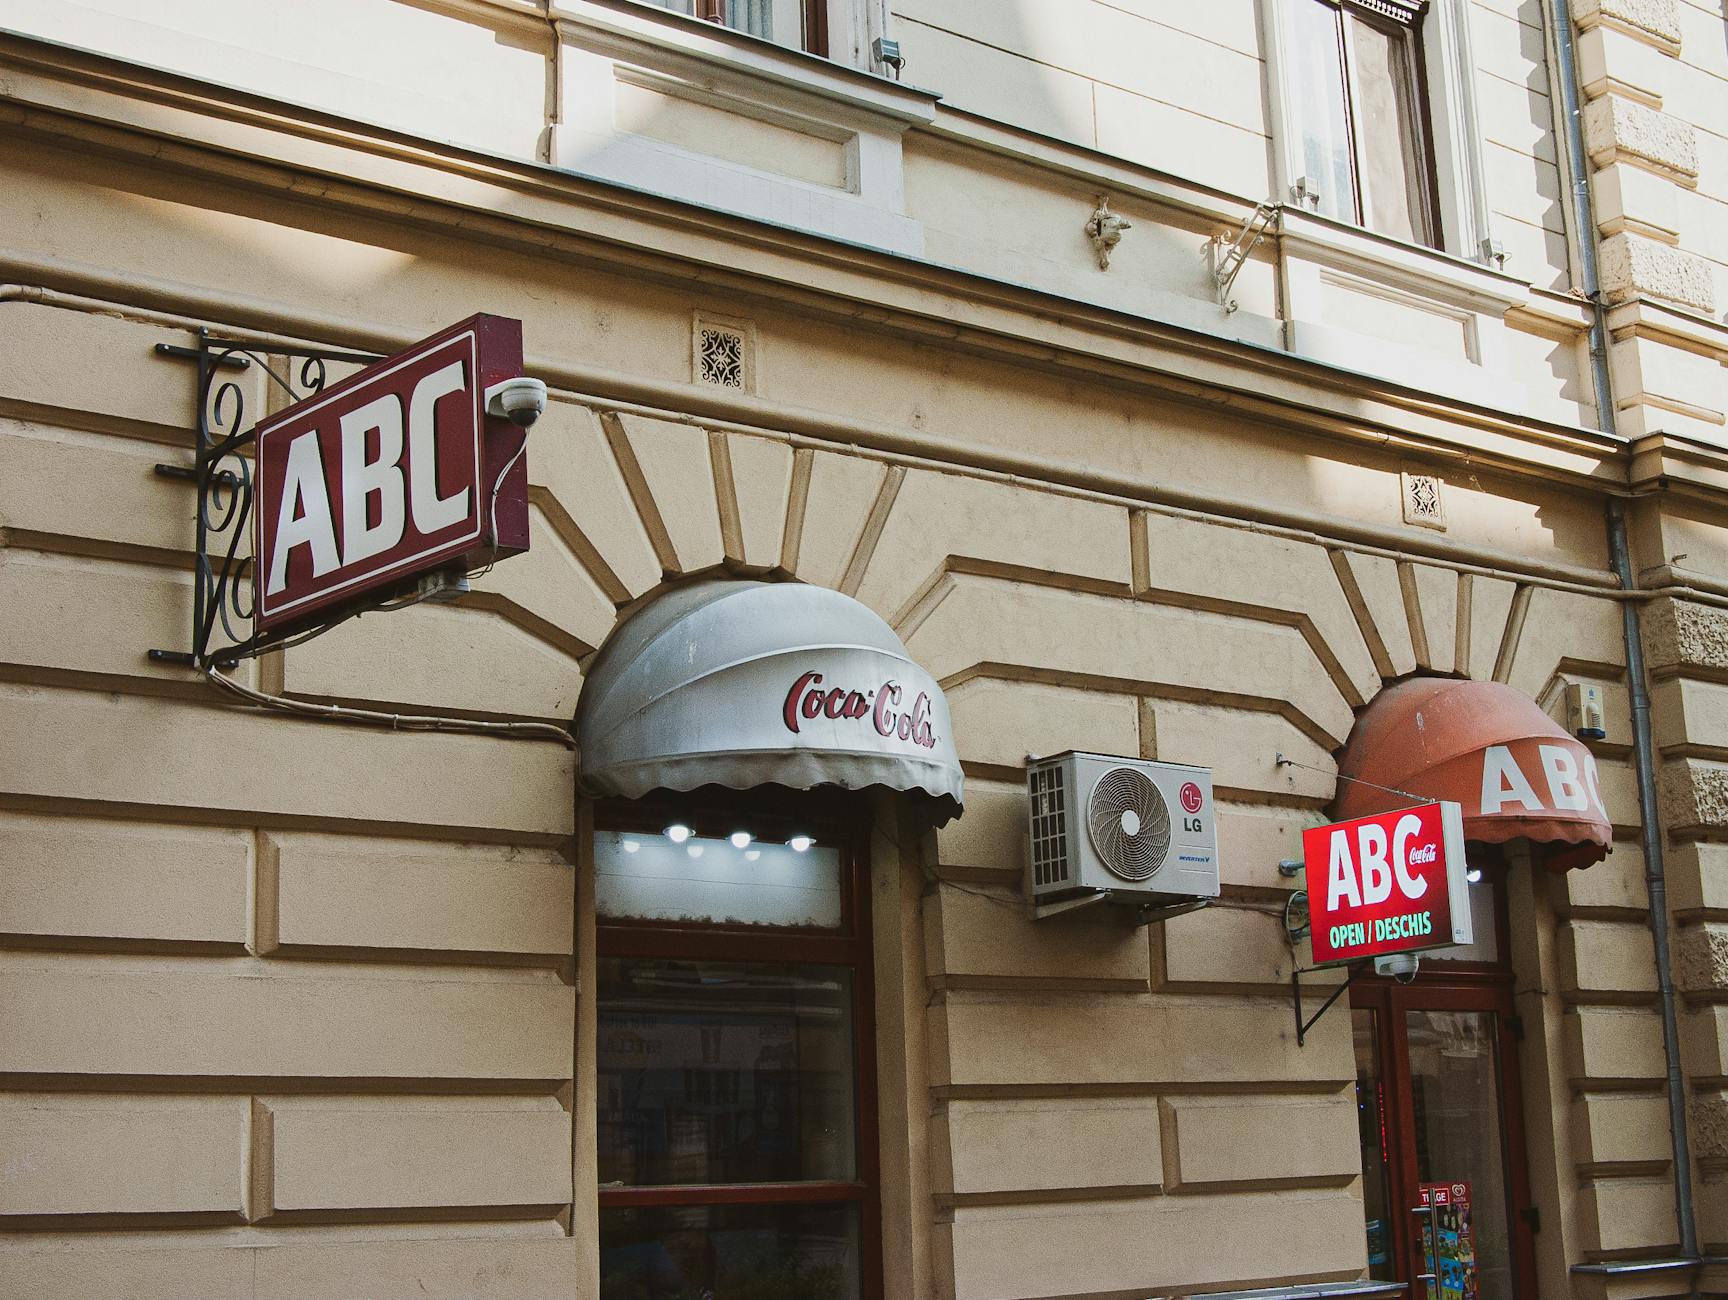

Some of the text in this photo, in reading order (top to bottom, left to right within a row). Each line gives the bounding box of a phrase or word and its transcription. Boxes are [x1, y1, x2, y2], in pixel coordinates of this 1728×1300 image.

[267, 360, 470, 596] ABC
[1184, 817, 1202, 833] LG
[1327, 814, 1428, 912] ABC
[1330, 921, 1365, 949] OPEN
[1367, 920, 1372, 944] /
[1375, 911, 1432, 942] DESCHIS
